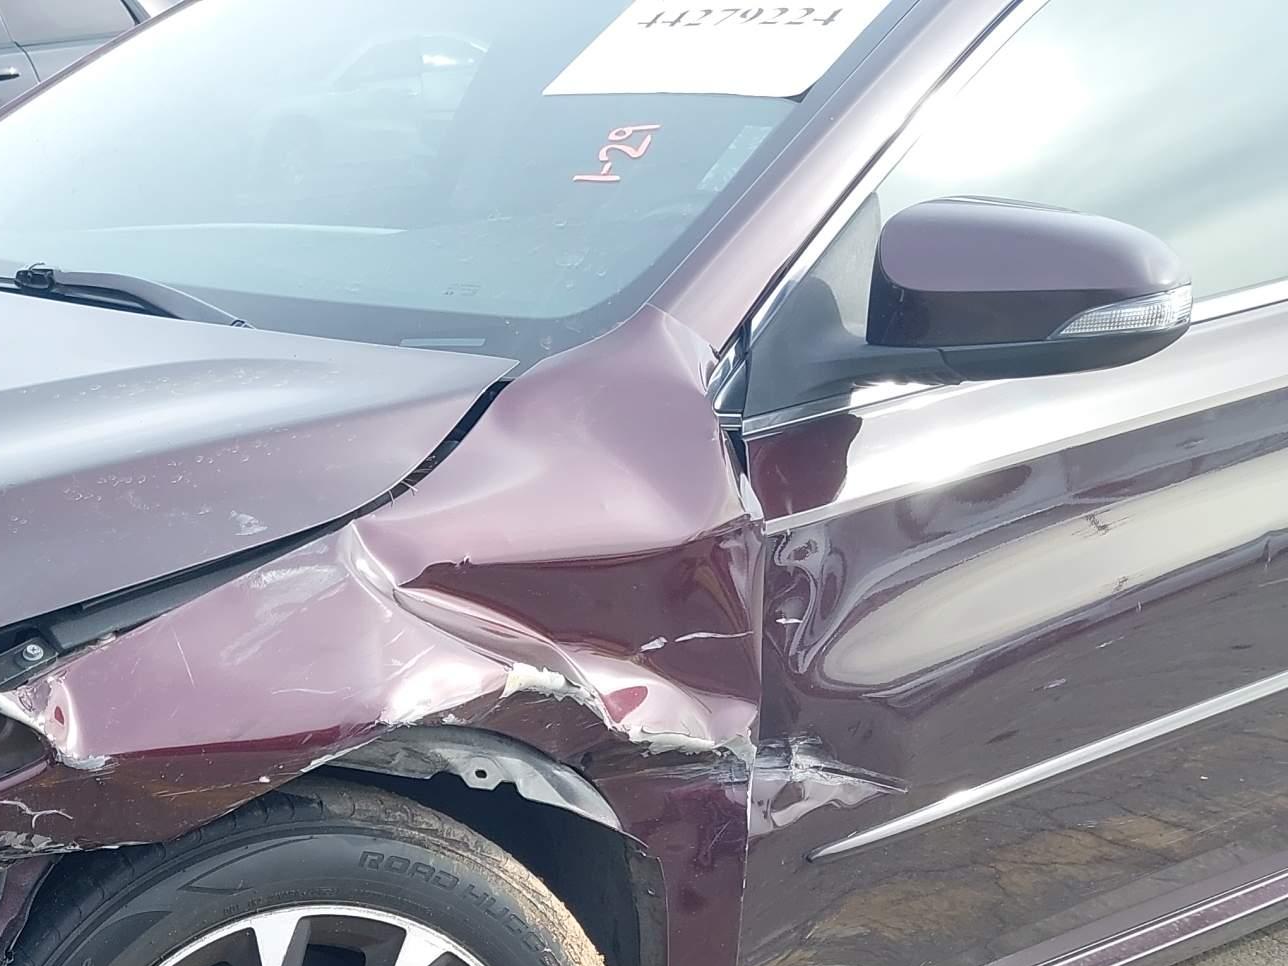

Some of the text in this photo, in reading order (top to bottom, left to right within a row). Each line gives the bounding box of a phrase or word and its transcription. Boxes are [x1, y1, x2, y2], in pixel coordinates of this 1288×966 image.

[637, 7, 844, 28] 44279224
[573, 124, 662, 182] 1-29
[359, 850, 460, 890] ROAD
